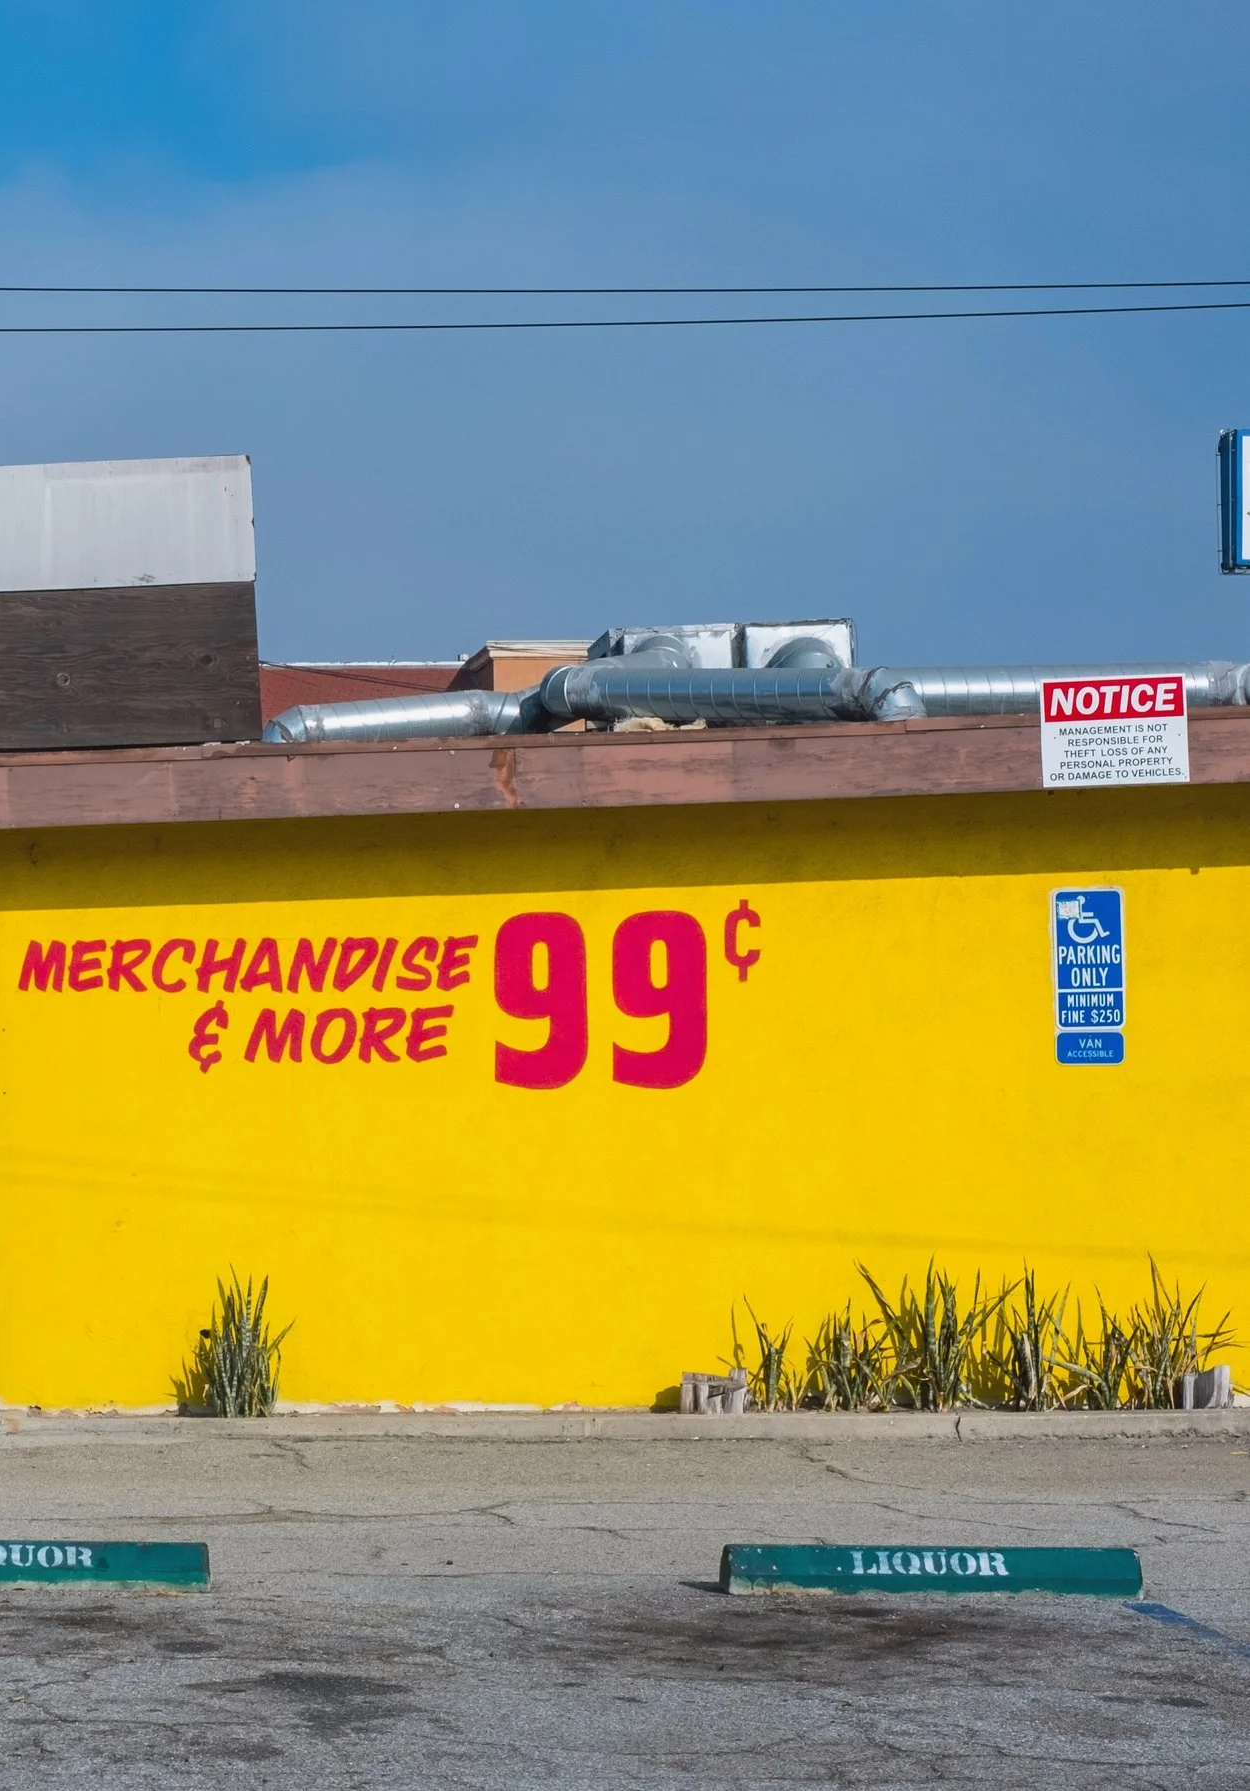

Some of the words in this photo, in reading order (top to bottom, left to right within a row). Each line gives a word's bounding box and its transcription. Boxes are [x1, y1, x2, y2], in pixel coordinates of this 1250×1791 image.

[1050, 683, 1178, 717] NOTICE
[1059, 725, 1132, 736] MANAGEMENT
[1135, 724, 1144, 733] IS
[1147, 723, 1168, 732] NOT
[1068, 736, 1139, 747] RESPONSIBLE
[1142, 735, 1163, 743] FOR
[1064, 748, 1096, 758] THEFT
[1101, 747, 1128, 757] LOSS
[1131, 746, 1144, 755] OF
[1147, 746, 1168, 754] ANY
[1060, 759, 1115, 770] PERSONAL
[1118, 757, 1173, 767] PROPERTY
[1050, 773, 1065, 781] OR
[1068, 771, 1112, 781] DAMAGE
[1115, 769, 1129, 778] TO
[1131, 768, 1184, 777] VEHICLES.
[1058, 944, 1121, 965] PARKING
[17, 934, 479, 994] MERCHANDISE
[1071, 966, 1109, 987] ONLY
[1067, 994, 1114, 1008] MINIMUM
[1061, 1010, 1085, 1024] FINE
[1091, 1009, 1121, 1024] $250
[243, 1003, 455, 1066] MORE
[1079, 1038, 1102, 1049] VAN
[1067, 1050, 1114, 1058] ACCESSIBLE
[851, 1549, 1009, 1576] LIQUOR
